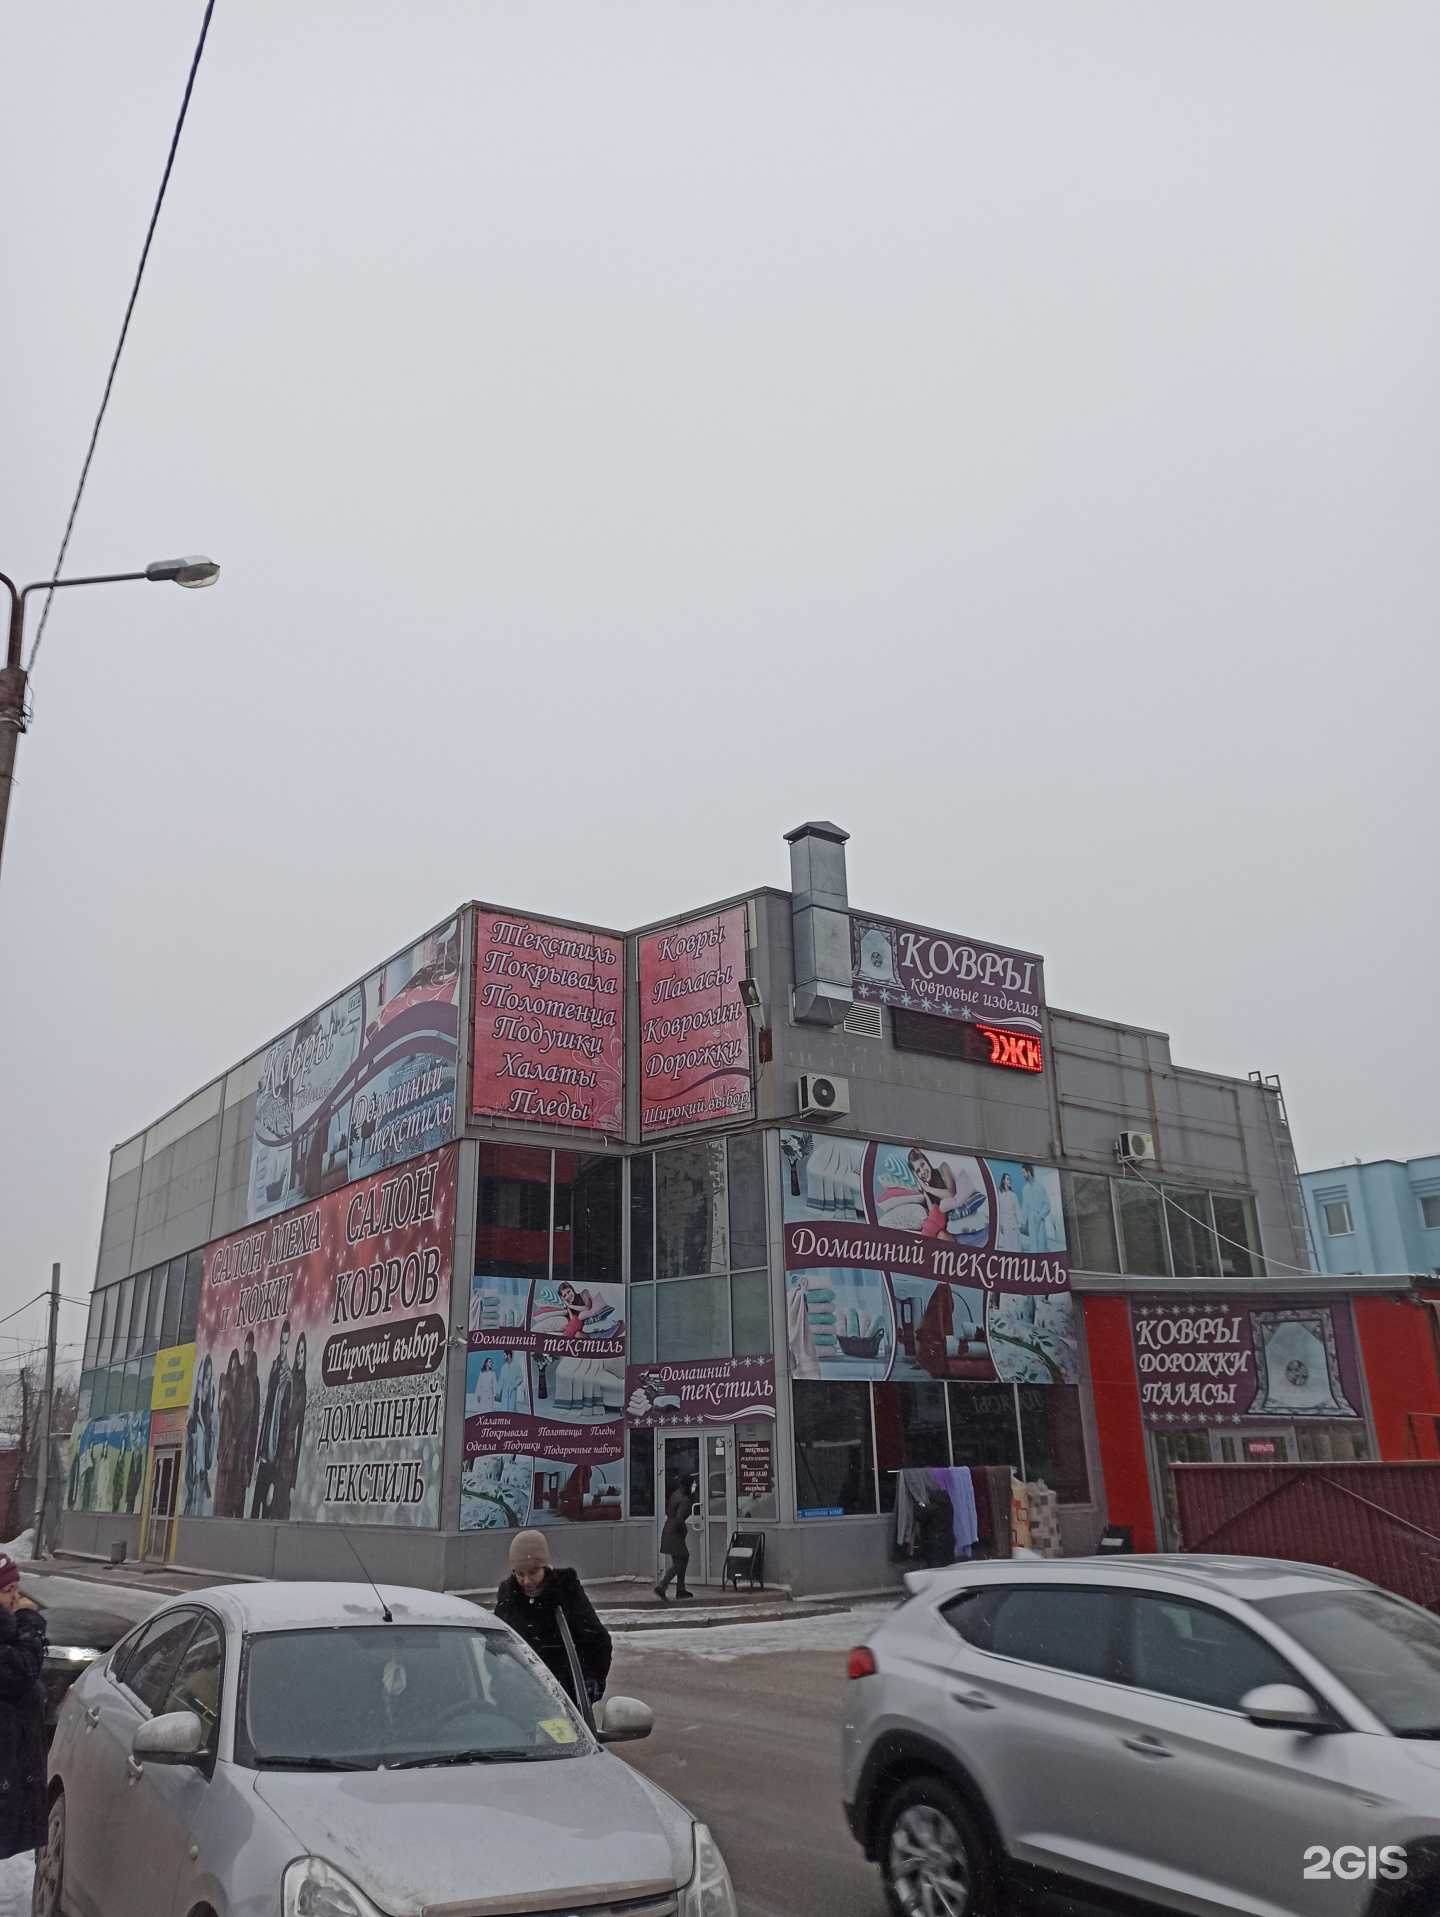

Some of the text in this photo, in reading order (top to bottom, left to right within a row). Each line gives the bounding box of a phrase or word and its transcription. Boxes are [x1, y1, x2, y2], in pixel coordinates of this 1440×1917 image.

[491, 921, 616, 965] Текстиль
[658, 924, 725, 962] Ковры
[900, 933, 1034, 994] КОВРЫ
[483, 951, 617, 995] Покрывала
[652, 966, 732, 1004] Паласы
[481, 984, 616, 1028] Полотенца
[911, 978, 1039, 1017] ковровые изделия
[493, 1016, 604, 1058] Подушки
[644, 1002, 742, 1044] Ковролин
[264, 1025, 334, 1098] Ковры
[497, 1053, 598, 1088] Халаты
[645, 1039, 741, 1079] Дорожки
[352, 1063, 444, 1131] Домашний
[508, 1089, 590, 1122] Пледы
[644, 1088, 750, 1125] Широкий выбор
[369, 1103, 452, 1155] текстиль
[346, 1162, 439, 1245] САЛОН
[211, 1209, 321, 1285] САЛОН МЕХА
[791, 1227, 1067, 1288] Домашний текстиль
[236, 1274, 292, 1329] КОЖИ
[332, 1248, 440, 1324] КОВРОВ
[327, 1322, 440, 1379] Широкий выбор
[472, 1331, 623, 1356] Домашний текстиль
[1136, 1317, 1242, 1350] КОВРЫ
[661, 1362, 731, 1382] Домашний
[1139, 1351, 1251, 1377] ДОРОЖКИ
[681, 1379, 773, 1405] текстиль
[1142, 1382, 1237, 1406] ПАЛАСЫ
[317, 1384, 441, 1449] ДОМАШНИЙ
[476, 1415, 511, 1426] Халаты
[481, 1428, 528, 1440] Покрывала
[538, 1426, 582, 1437] Полотенца
[503, 1440, 541, 1453] Подушки
[324, 1462, 424, 1504] ТЕКСТИЛЬ
